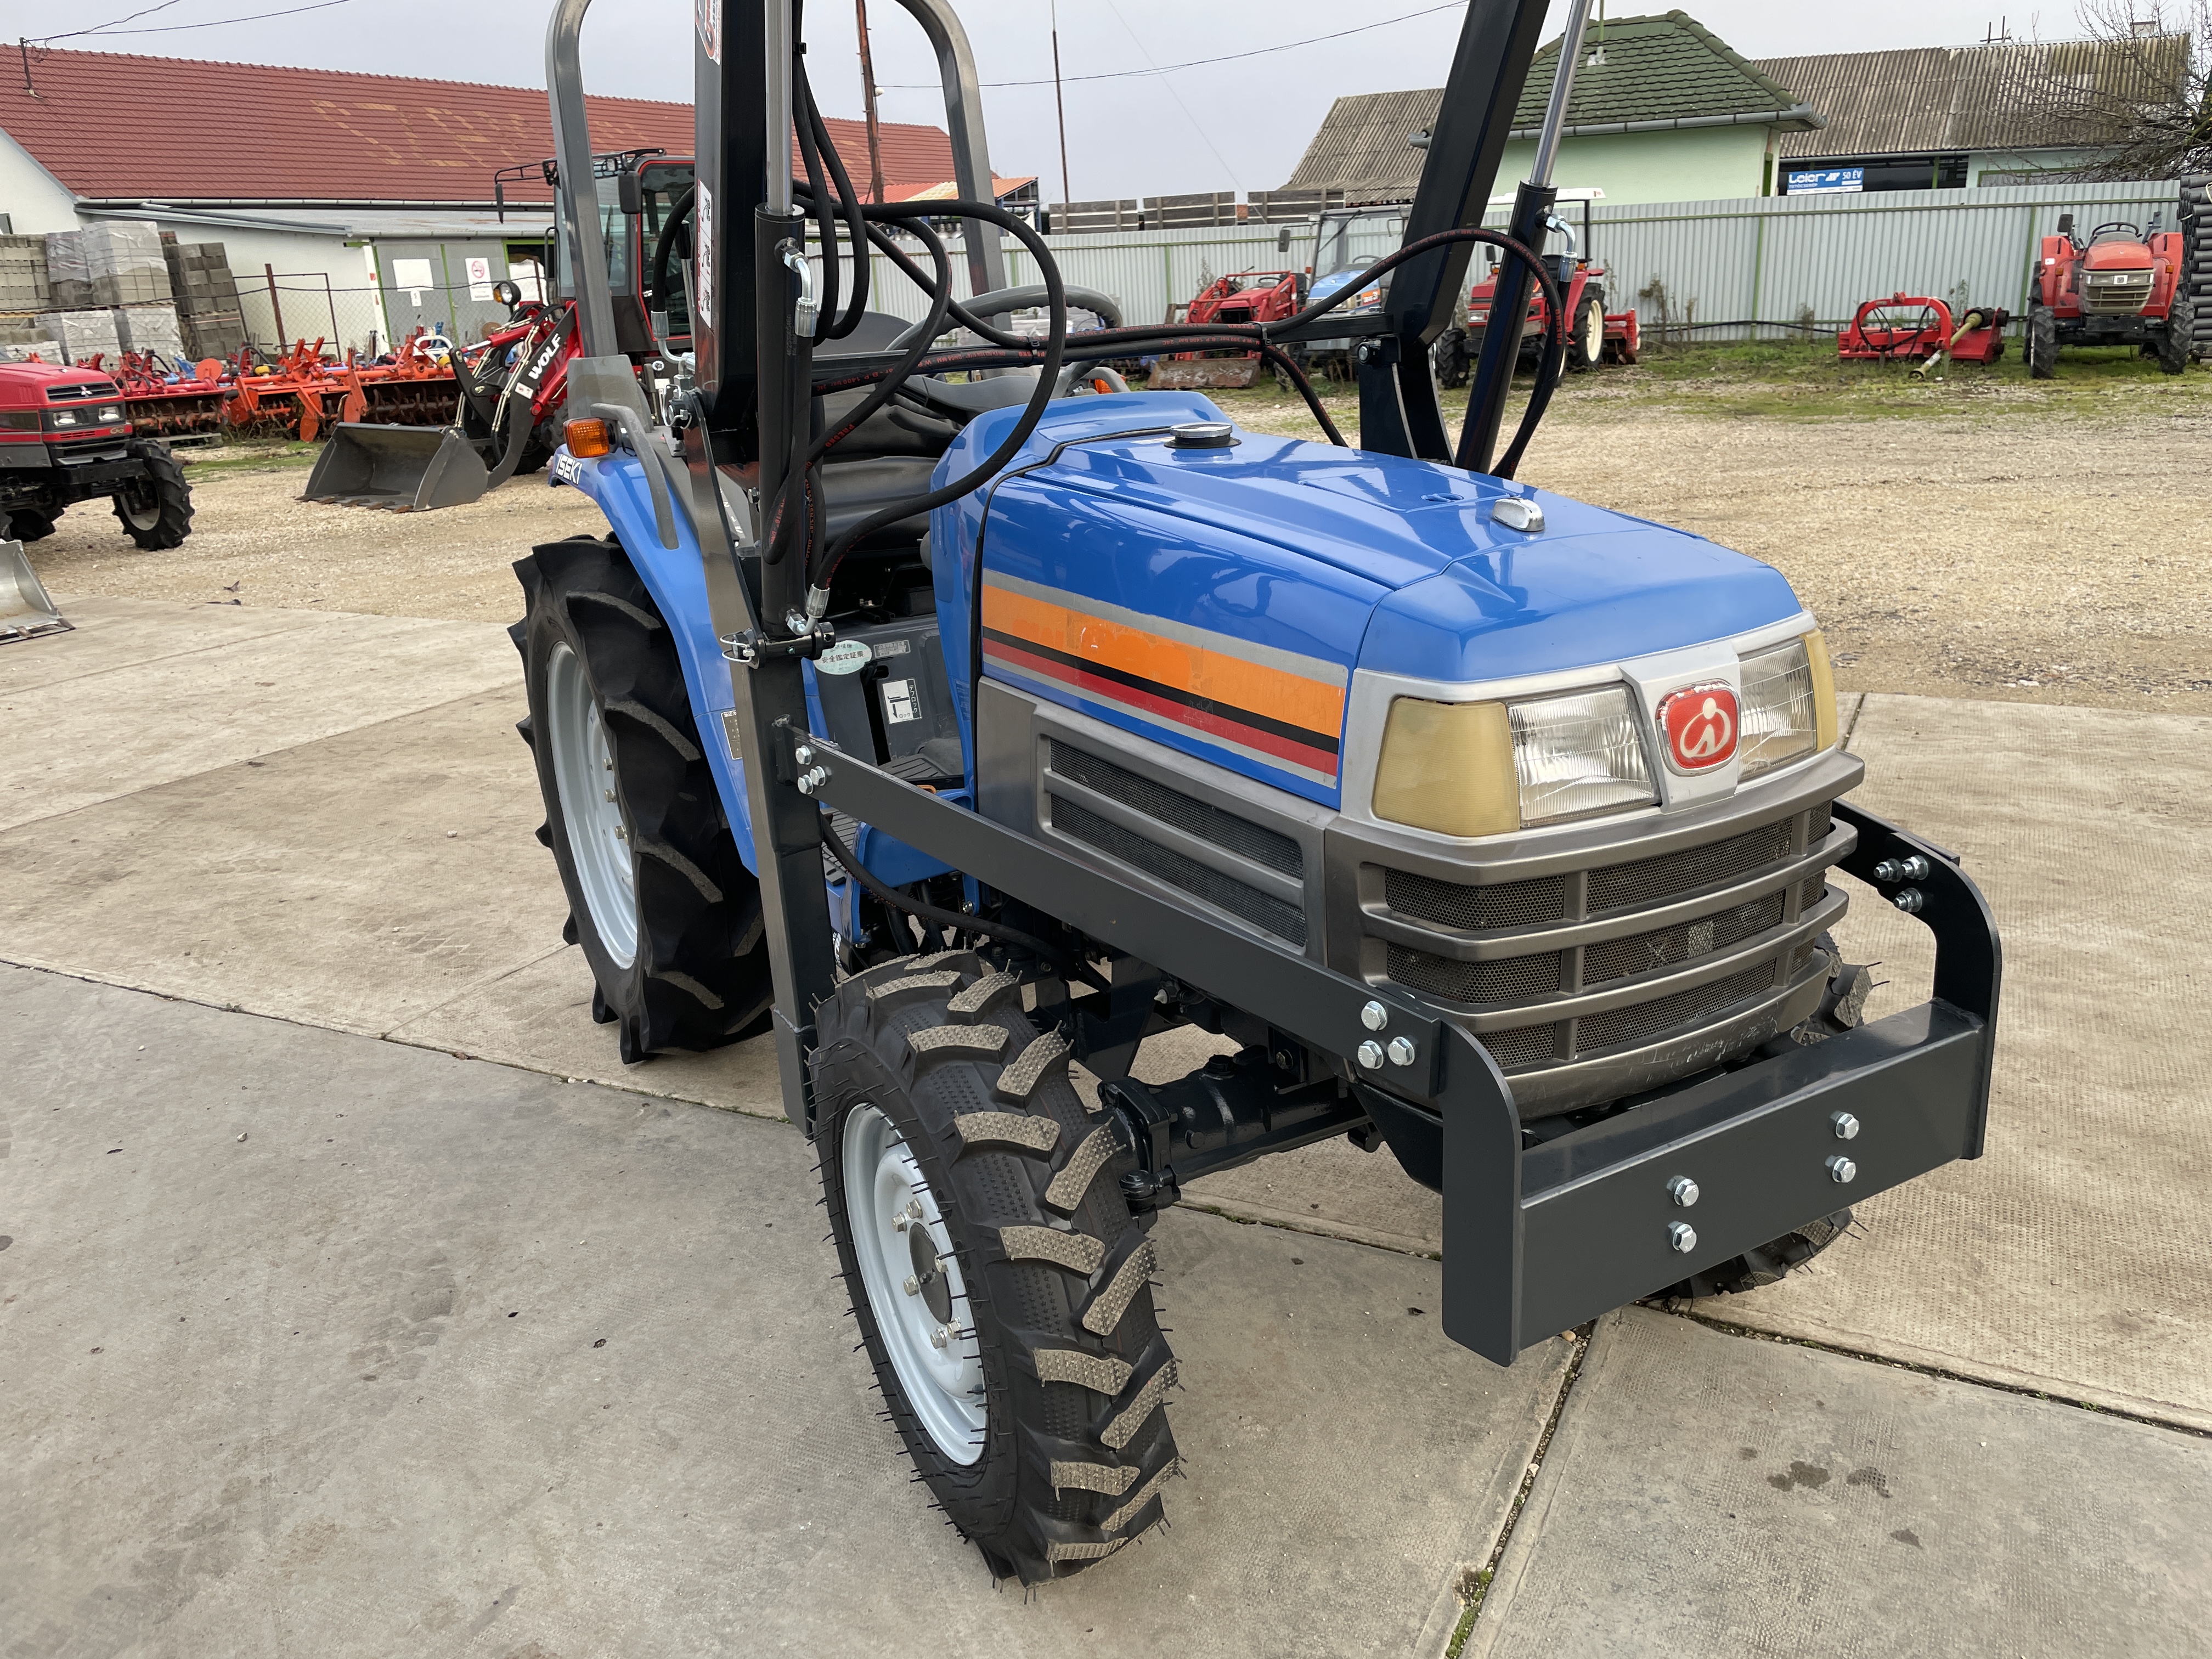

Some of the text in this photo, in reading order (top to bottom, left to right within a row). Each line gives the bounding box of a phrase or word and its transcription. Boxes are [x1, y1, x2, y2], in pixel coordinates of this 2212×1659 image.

[1842, 171, 1852, 180] 50
[528, 333, 561, 379] WOLF
[556, 454, 582, 484] ISEKI
[821, 651, 864, 663] 安全鑑定証票
